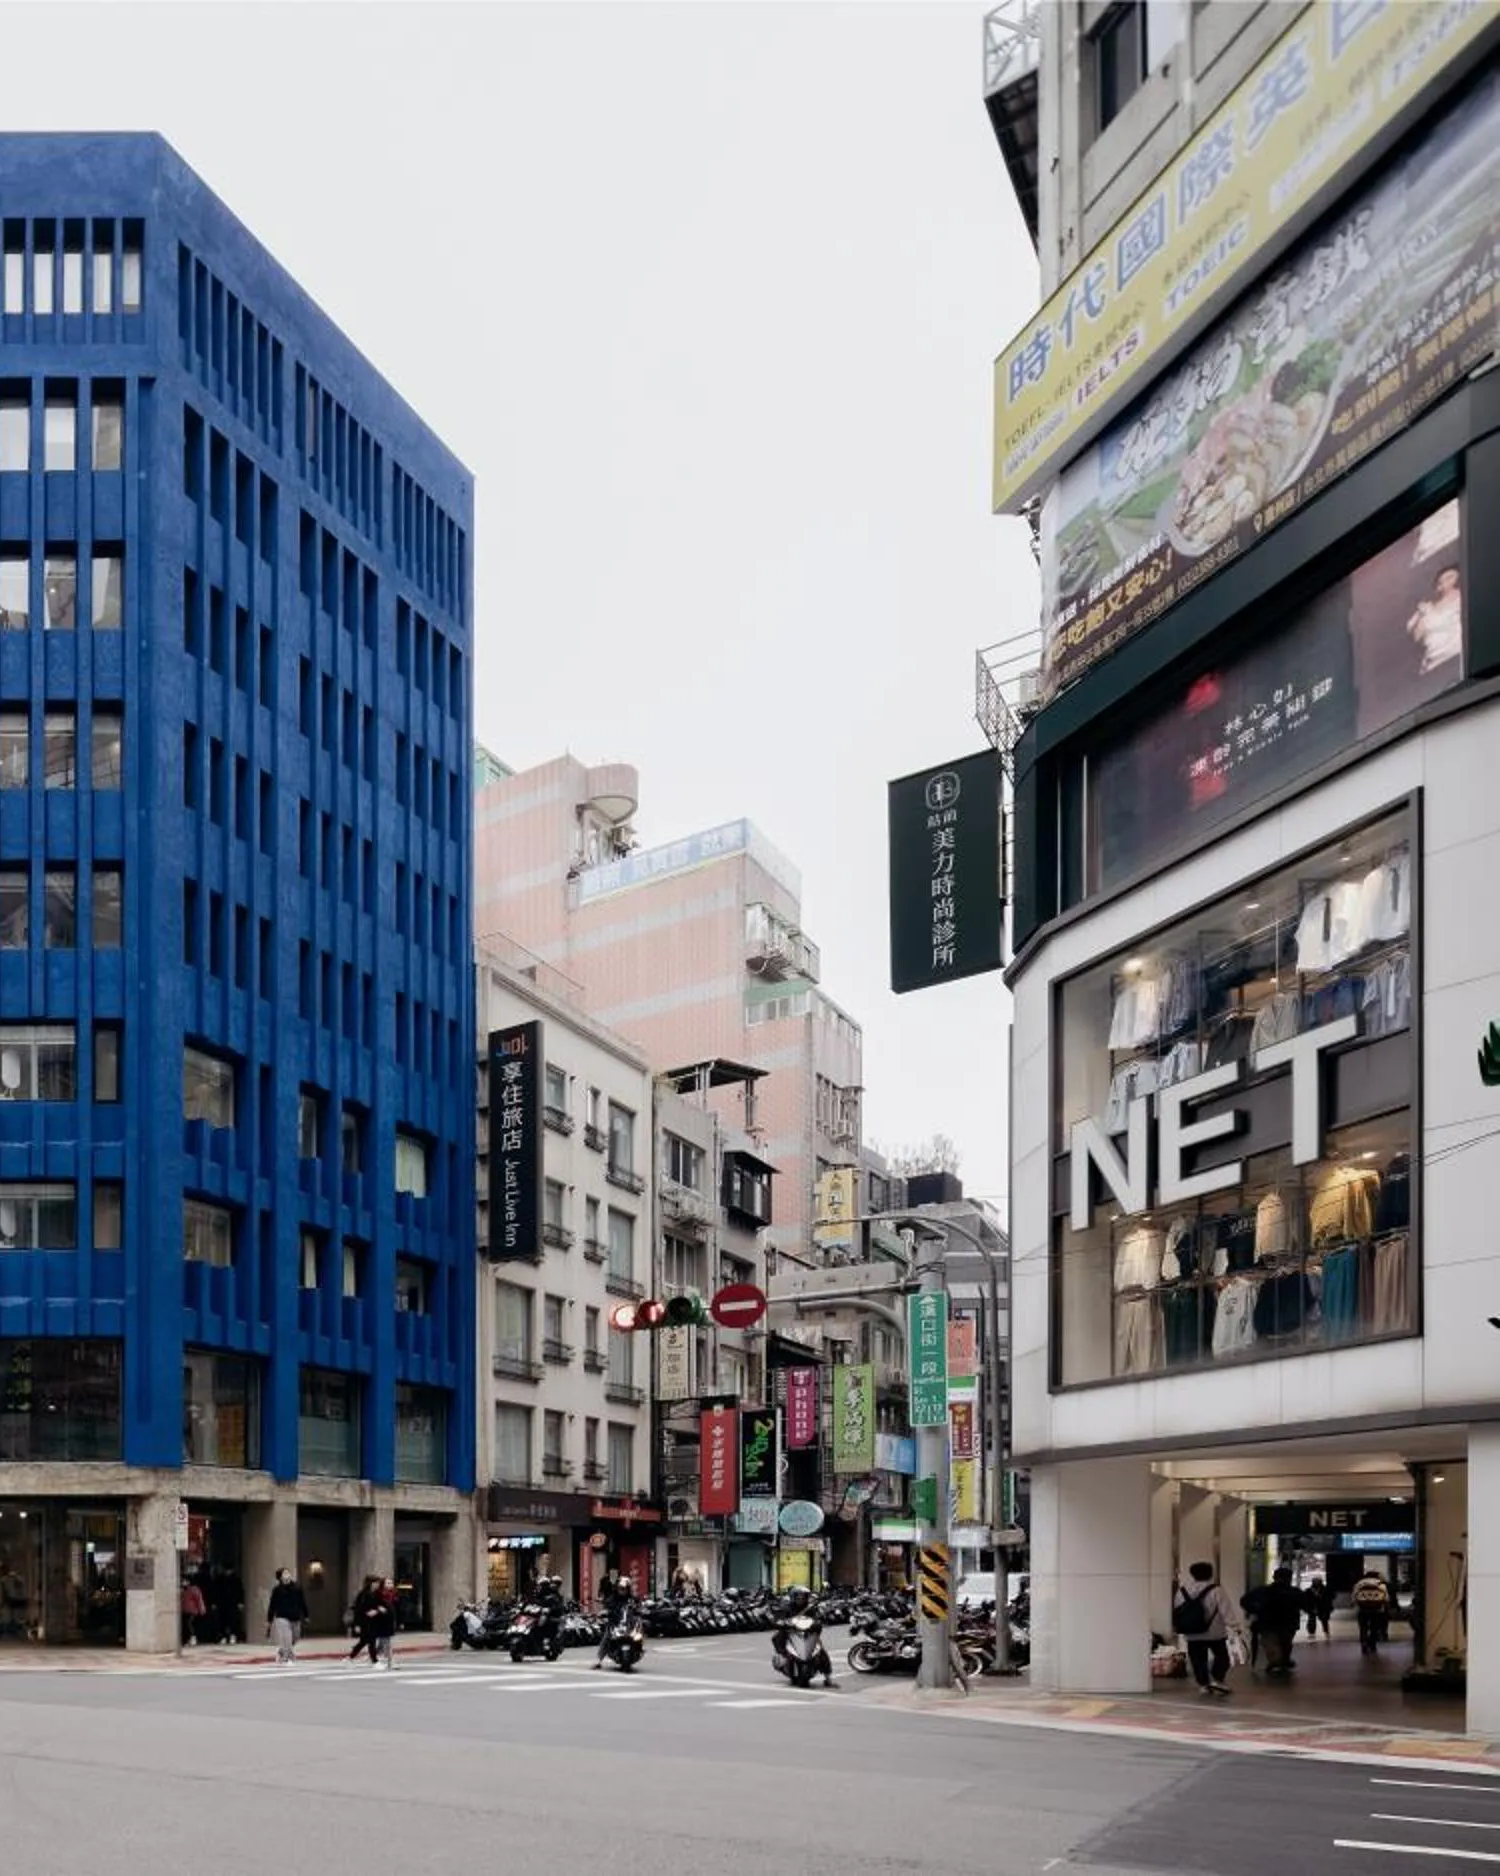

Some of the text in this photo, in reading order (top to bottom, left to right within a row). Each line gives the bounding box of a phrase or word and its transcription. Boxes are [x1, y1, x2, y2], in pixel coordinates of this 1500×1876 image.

[1076, 333, 1140, 406] IELTS
[931, 827, 957, 968] 美力時尚診所
[1070, 1015, 1362, 1232] NET
[1309, 1510, 1369, 1528] NET
